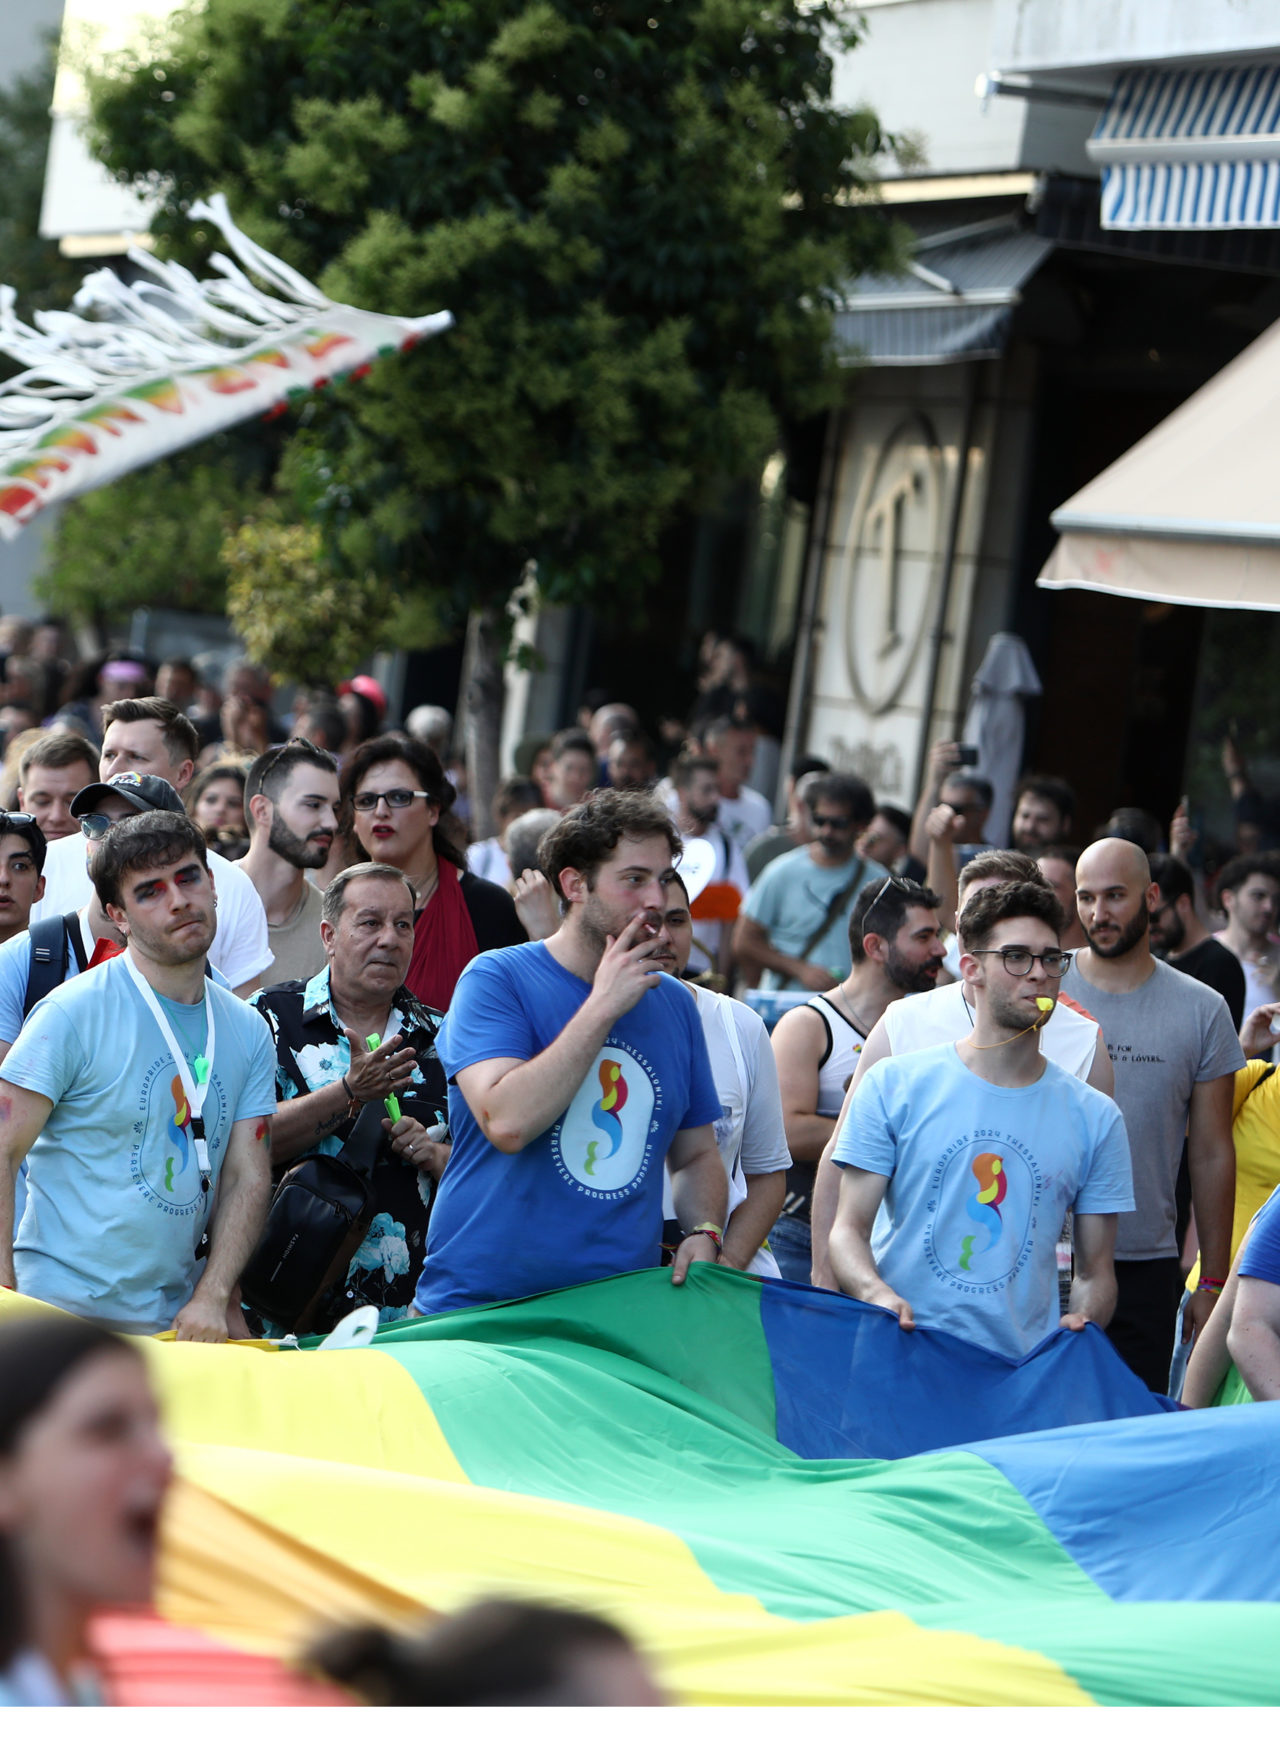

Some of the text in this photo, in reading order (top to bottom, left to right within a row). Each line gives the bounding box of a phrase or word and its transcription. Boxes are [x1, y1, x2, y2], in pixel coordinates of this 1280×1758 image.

[139, 1056, 165, 1111] EUROPRIDE
[621, 1041, 663, 1111] THESSALONIKI
[130, 1144, 198, 1216] PERSEVERE PROGRESS
[551, 1124, 653, 1200] PERSEVERE PROGRESS PROSPER
[932, 1135, 969, 1189] EUROPRIDE
[1006, 1135, 1042, 1206] THESSALONIKI
[950, 1281, 1005, 1295] PROGRESS
